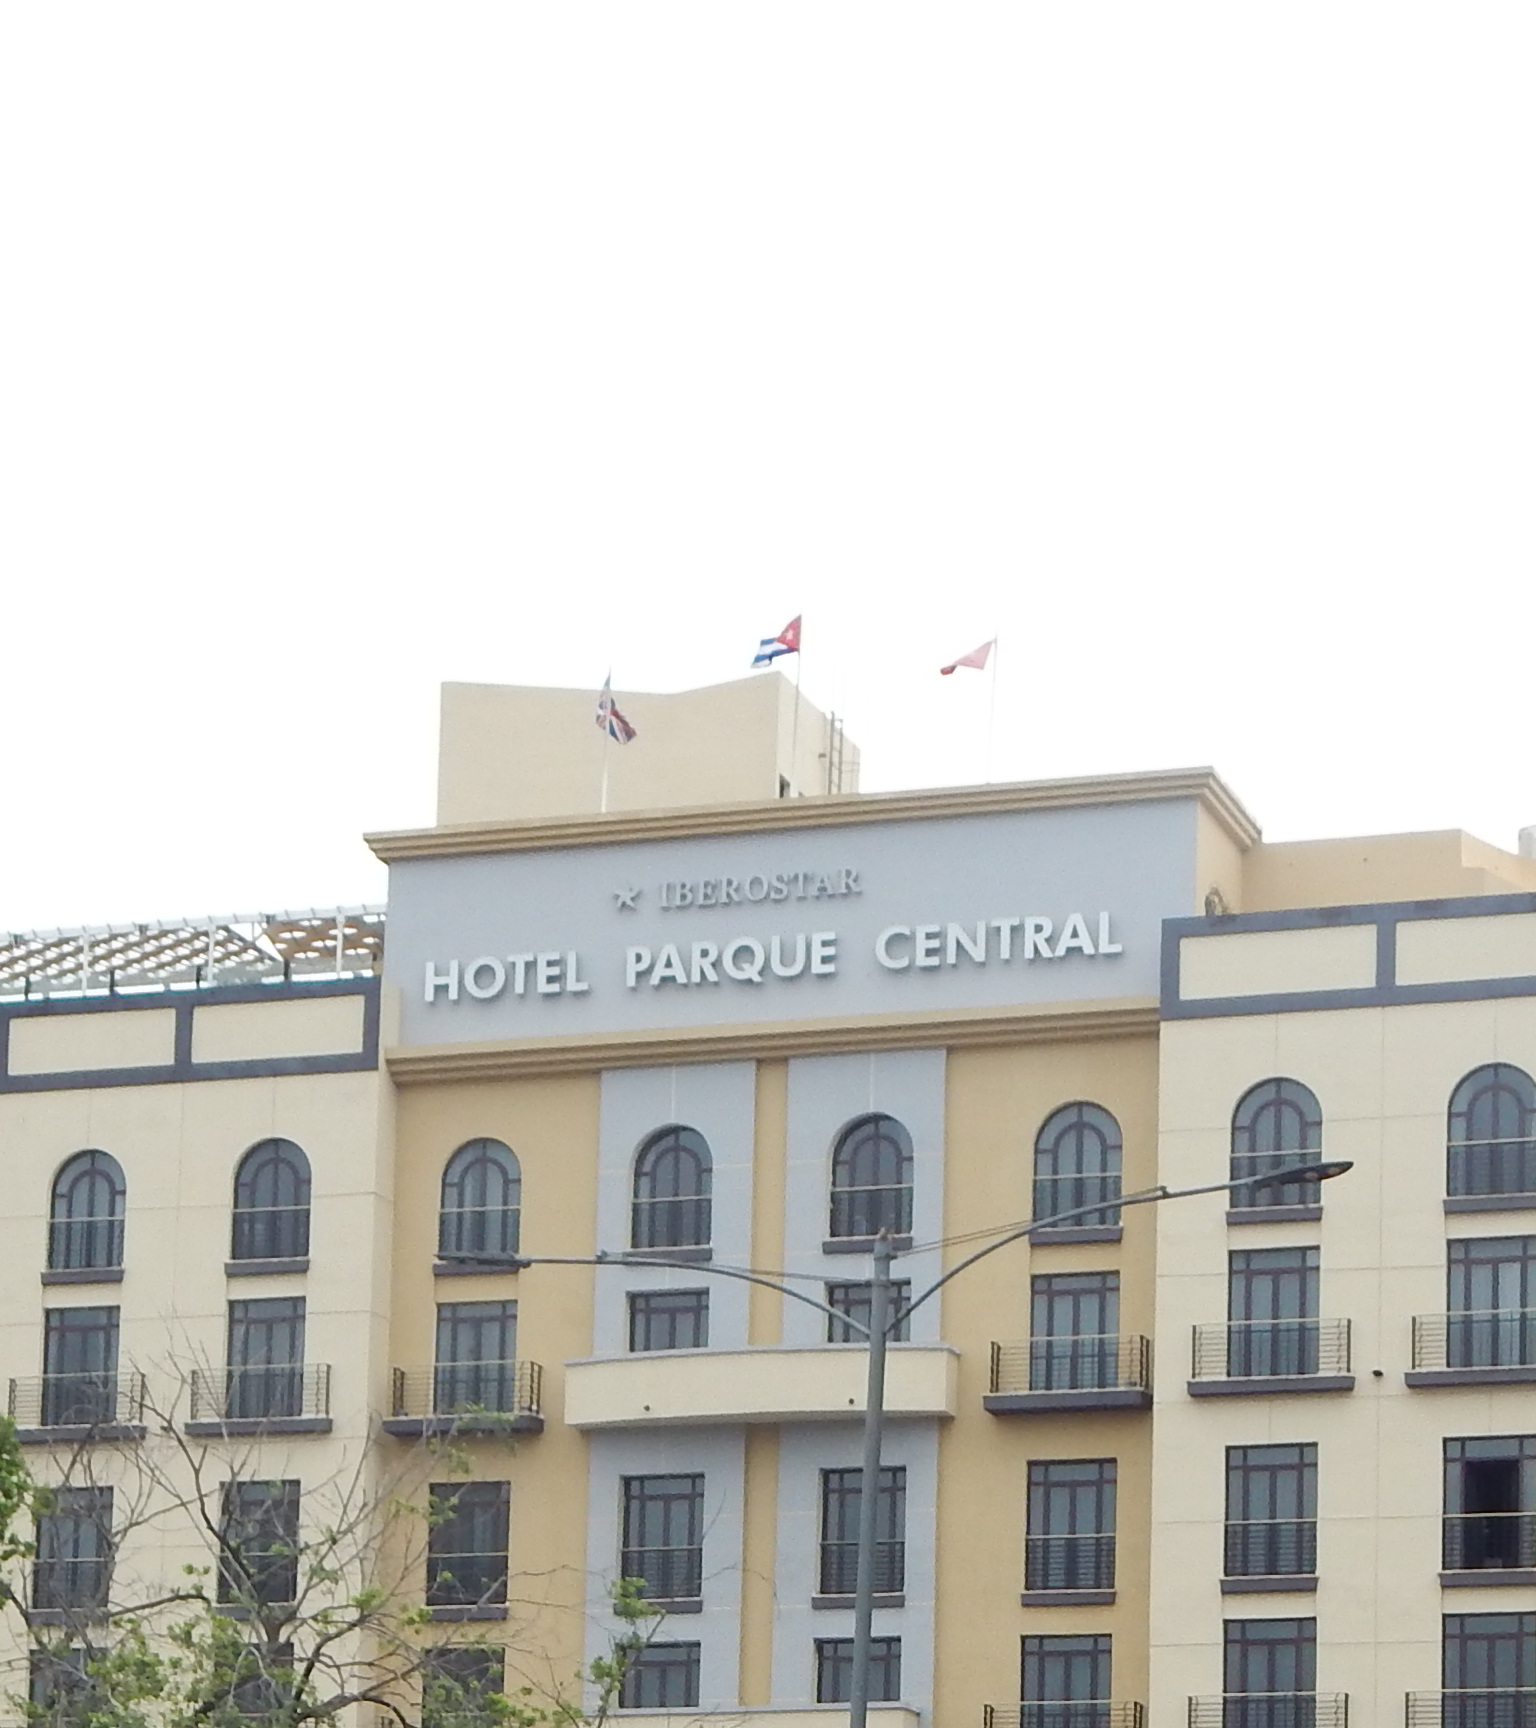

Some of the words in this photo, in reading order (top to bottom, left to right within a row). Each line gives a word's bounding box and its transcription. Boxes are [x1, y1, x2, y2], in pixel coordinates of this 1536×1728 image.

[660, 868, 863, 909] IBEROSTAR
[424, 950, 590, 1002] HOTEL
[626, 931, 837, 987] PARQUE
[875, 911, 1124, 969] CENTRAL
